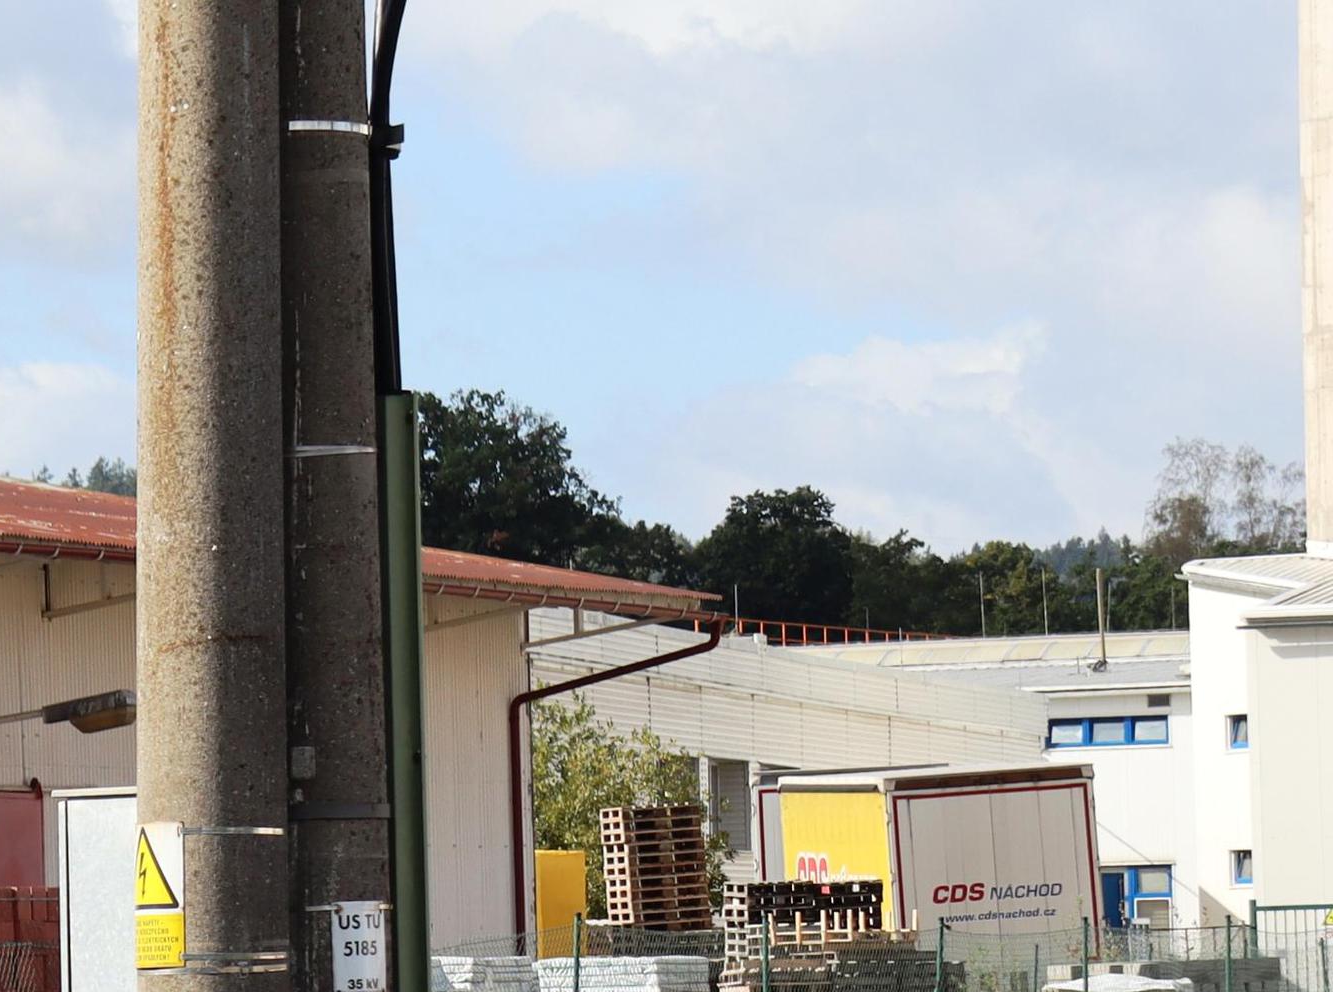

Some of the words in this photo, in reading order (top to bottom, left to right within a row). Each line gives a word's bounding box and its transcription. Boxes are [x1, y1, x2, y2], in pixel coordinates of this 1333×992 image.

[932, 882, 985, 904] CDS
[338, 914, 361, 930] US
[364, 914, 381, 929] TU
[945, 907, 1057, 923] www.cdsnachod.cz
[343, 940, 378, 957] 5185
[347, 979, 364, 990] 35
[366, 978, 379, 989] kV
